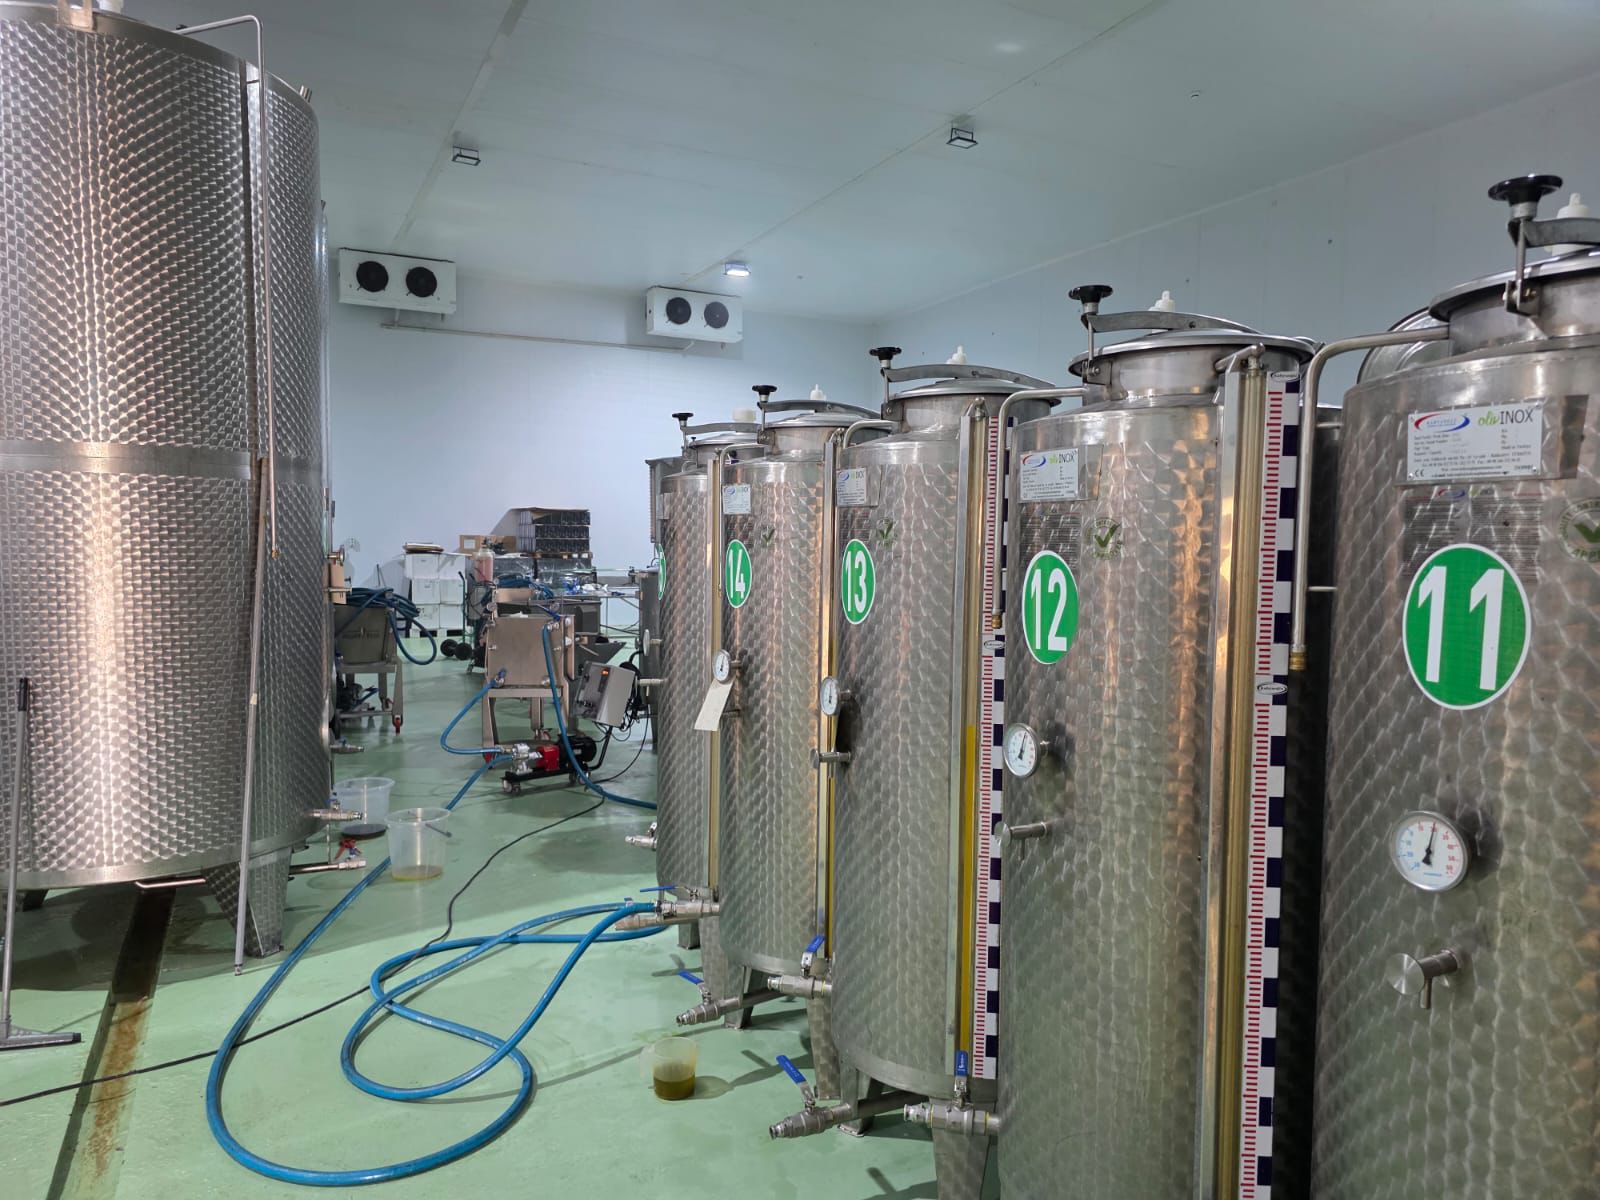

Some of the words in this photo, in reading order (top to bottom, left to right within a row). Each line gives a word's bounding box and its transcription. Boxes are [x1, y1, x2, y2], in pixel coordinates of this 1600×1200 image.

[728, 549, 746, 599] 14
[845, 550, 868, 613] 13
[1030, 568, 1068, 652] 12
[1418, 565, 1505, 691] 11
